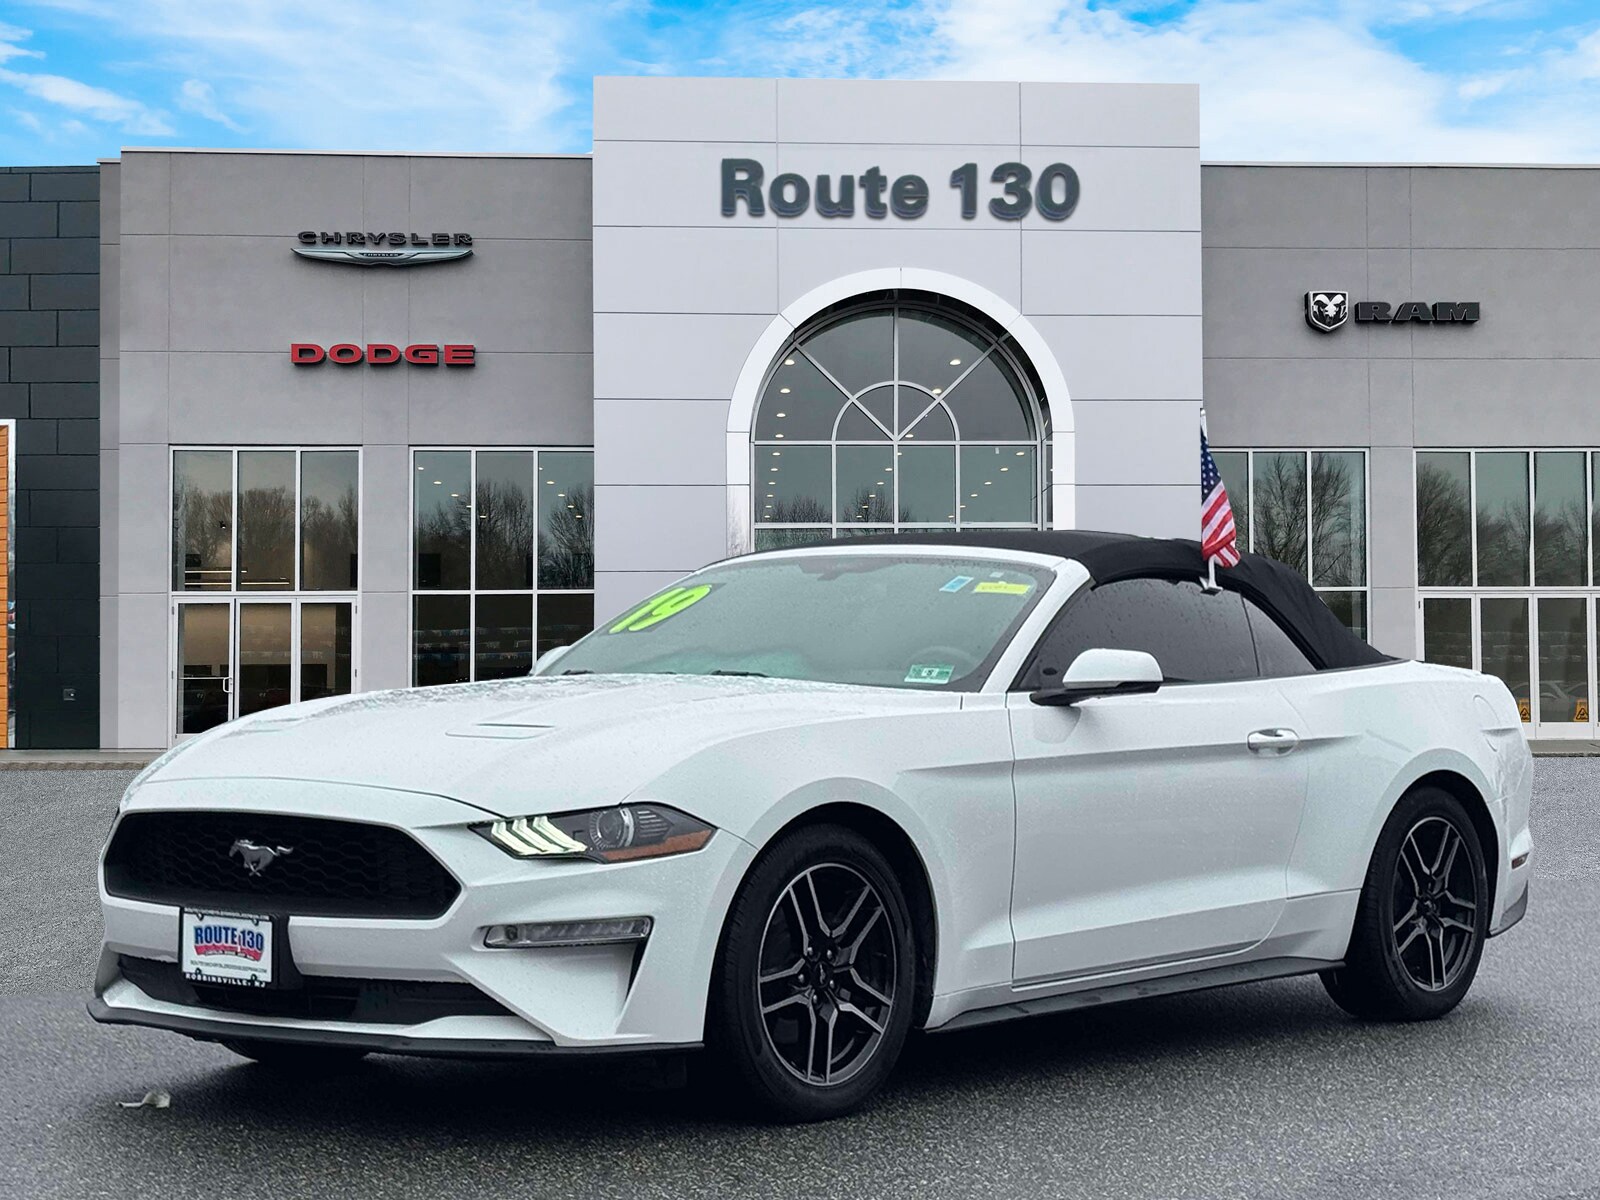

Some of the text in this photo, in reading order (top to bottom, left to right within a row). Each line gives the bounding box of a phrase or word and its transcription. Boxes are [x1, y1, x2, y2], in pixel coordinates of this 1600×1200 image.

[721, 158, 1080, 221] Route 130
[297, 231, 473, 246] CHRYSLER
[1354, 301, 1481, 325] RAM
[290, 343, 476, 367] DODGE
[194, 926, 264, 951] ROUTE 130
